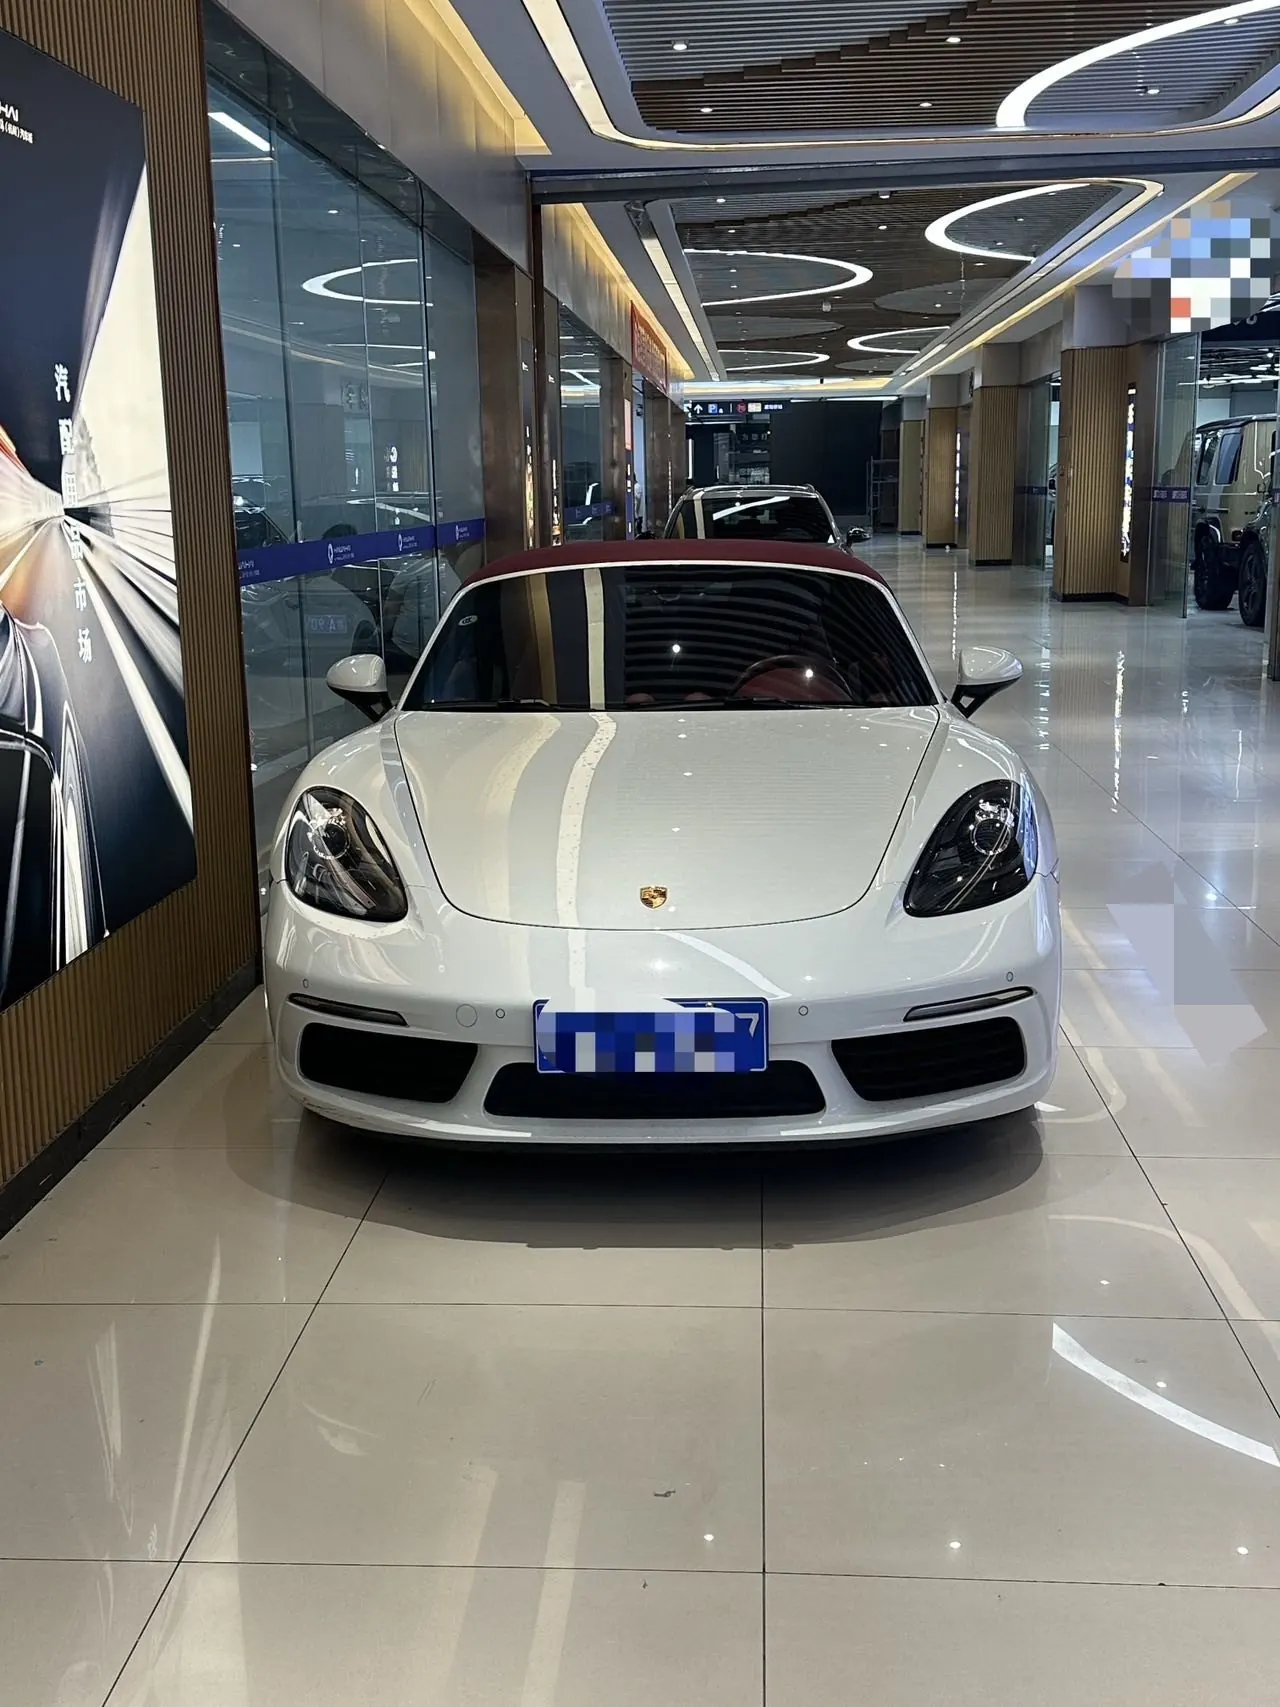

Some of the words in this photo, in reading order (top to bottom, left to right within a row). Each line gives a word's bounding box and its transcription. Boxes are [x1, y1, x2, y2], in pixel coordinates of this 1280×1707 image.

[54, 364, 93, 664] 汽配用品市场
